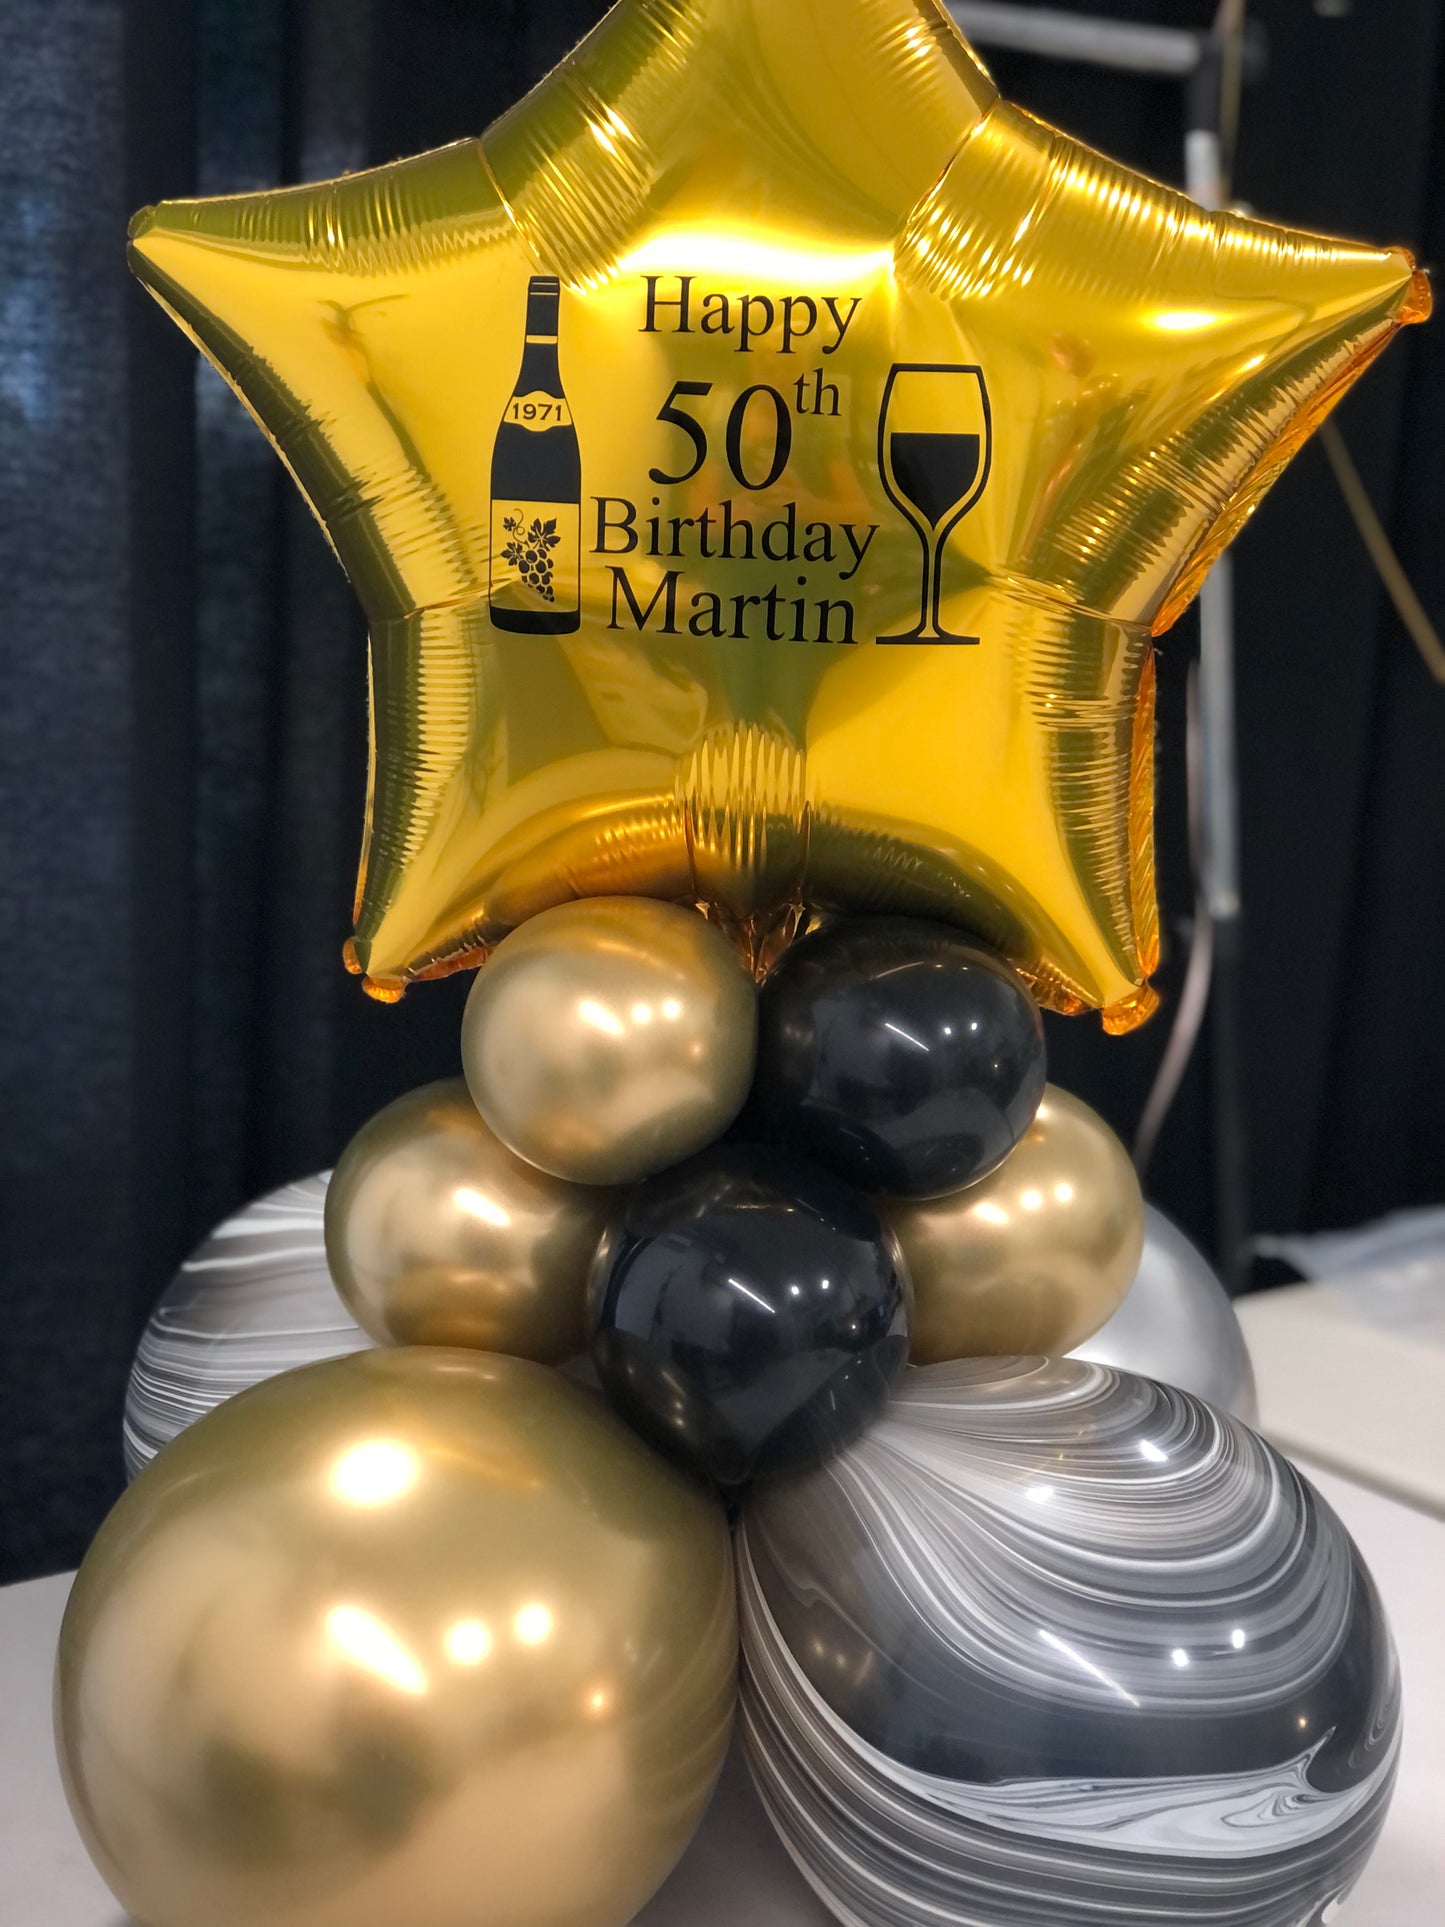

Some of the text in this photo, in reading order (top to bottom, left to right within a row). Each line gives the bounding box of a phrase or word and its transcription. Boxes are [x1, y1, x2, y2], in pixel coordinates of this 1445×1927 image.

[638, 275, 862, 354] Happy
[512, 403, 562, 422] 1971
[648, 368, 842, 490] 50th
[589, 496, 879, 580] Birthday
[605, 565, 859, 644] Martin
